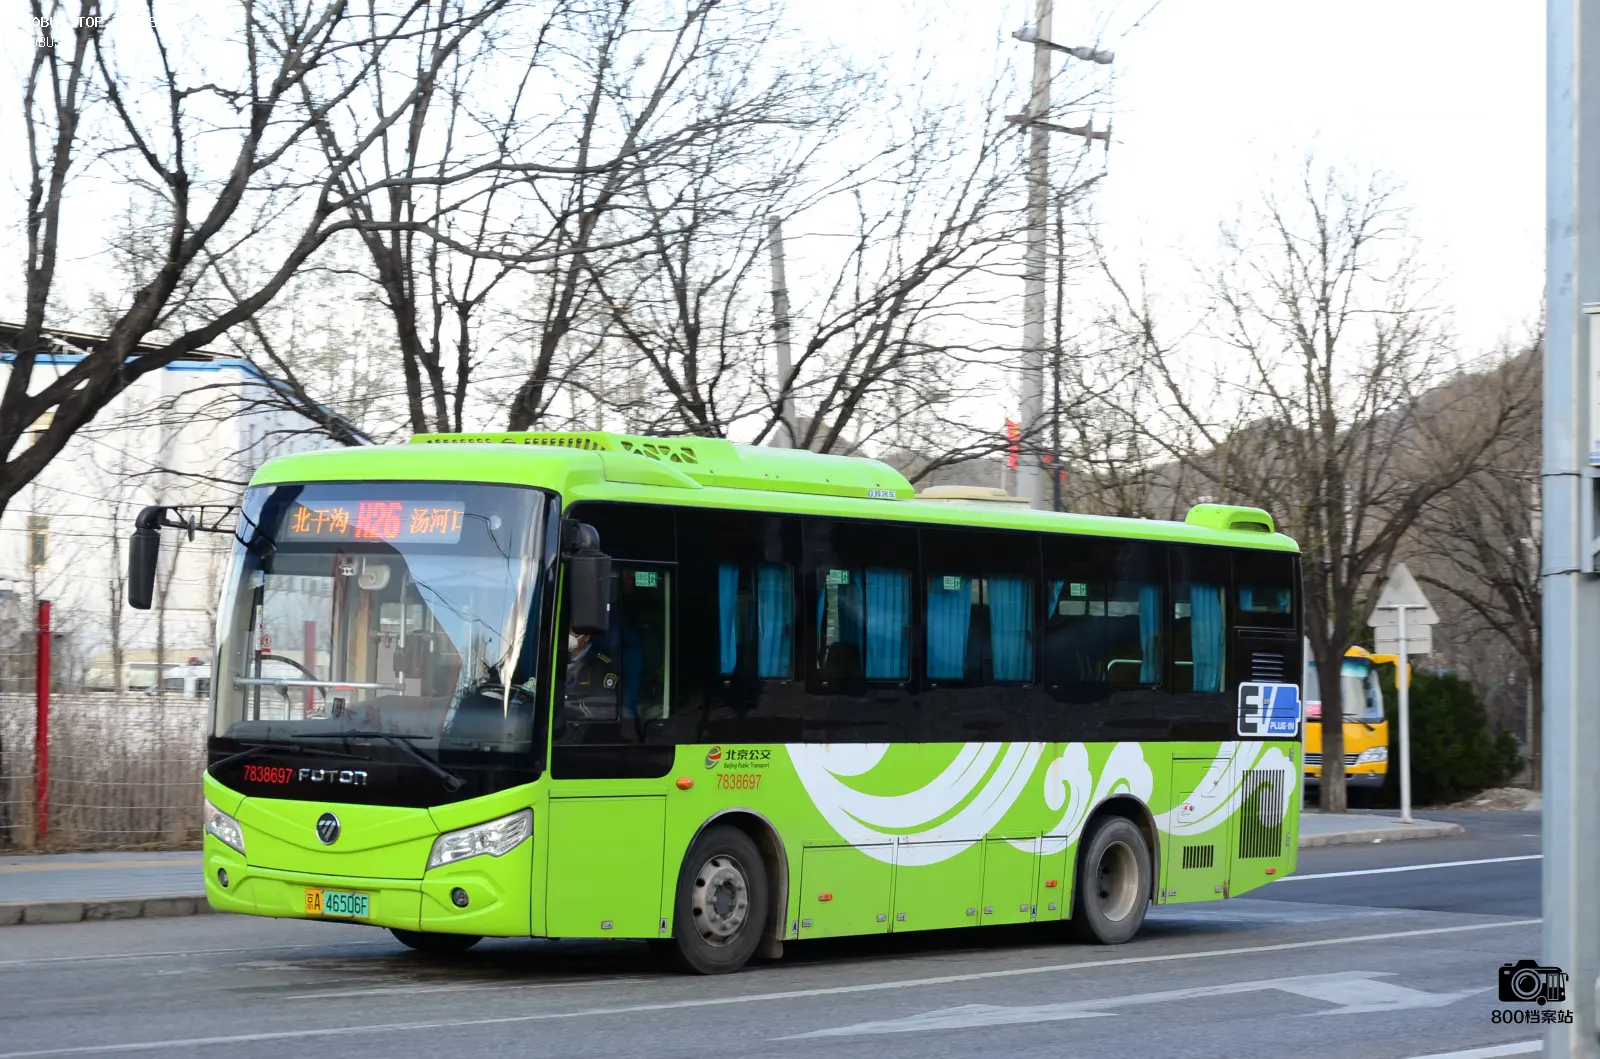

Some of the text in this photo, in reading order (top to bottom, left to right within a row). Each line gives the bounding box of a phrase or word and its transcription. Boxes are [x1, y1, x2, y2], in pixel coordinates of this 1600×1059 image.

[292, 506, 350, 535] 北干沟
[355, 502, 404, 539] H26
[725, 749, 771, 760] 北京公交
[243, 765, 293, 784] 7838697
[298, 768, 368, 785] FOTON
[716, 773, 762, 789] 7838697
